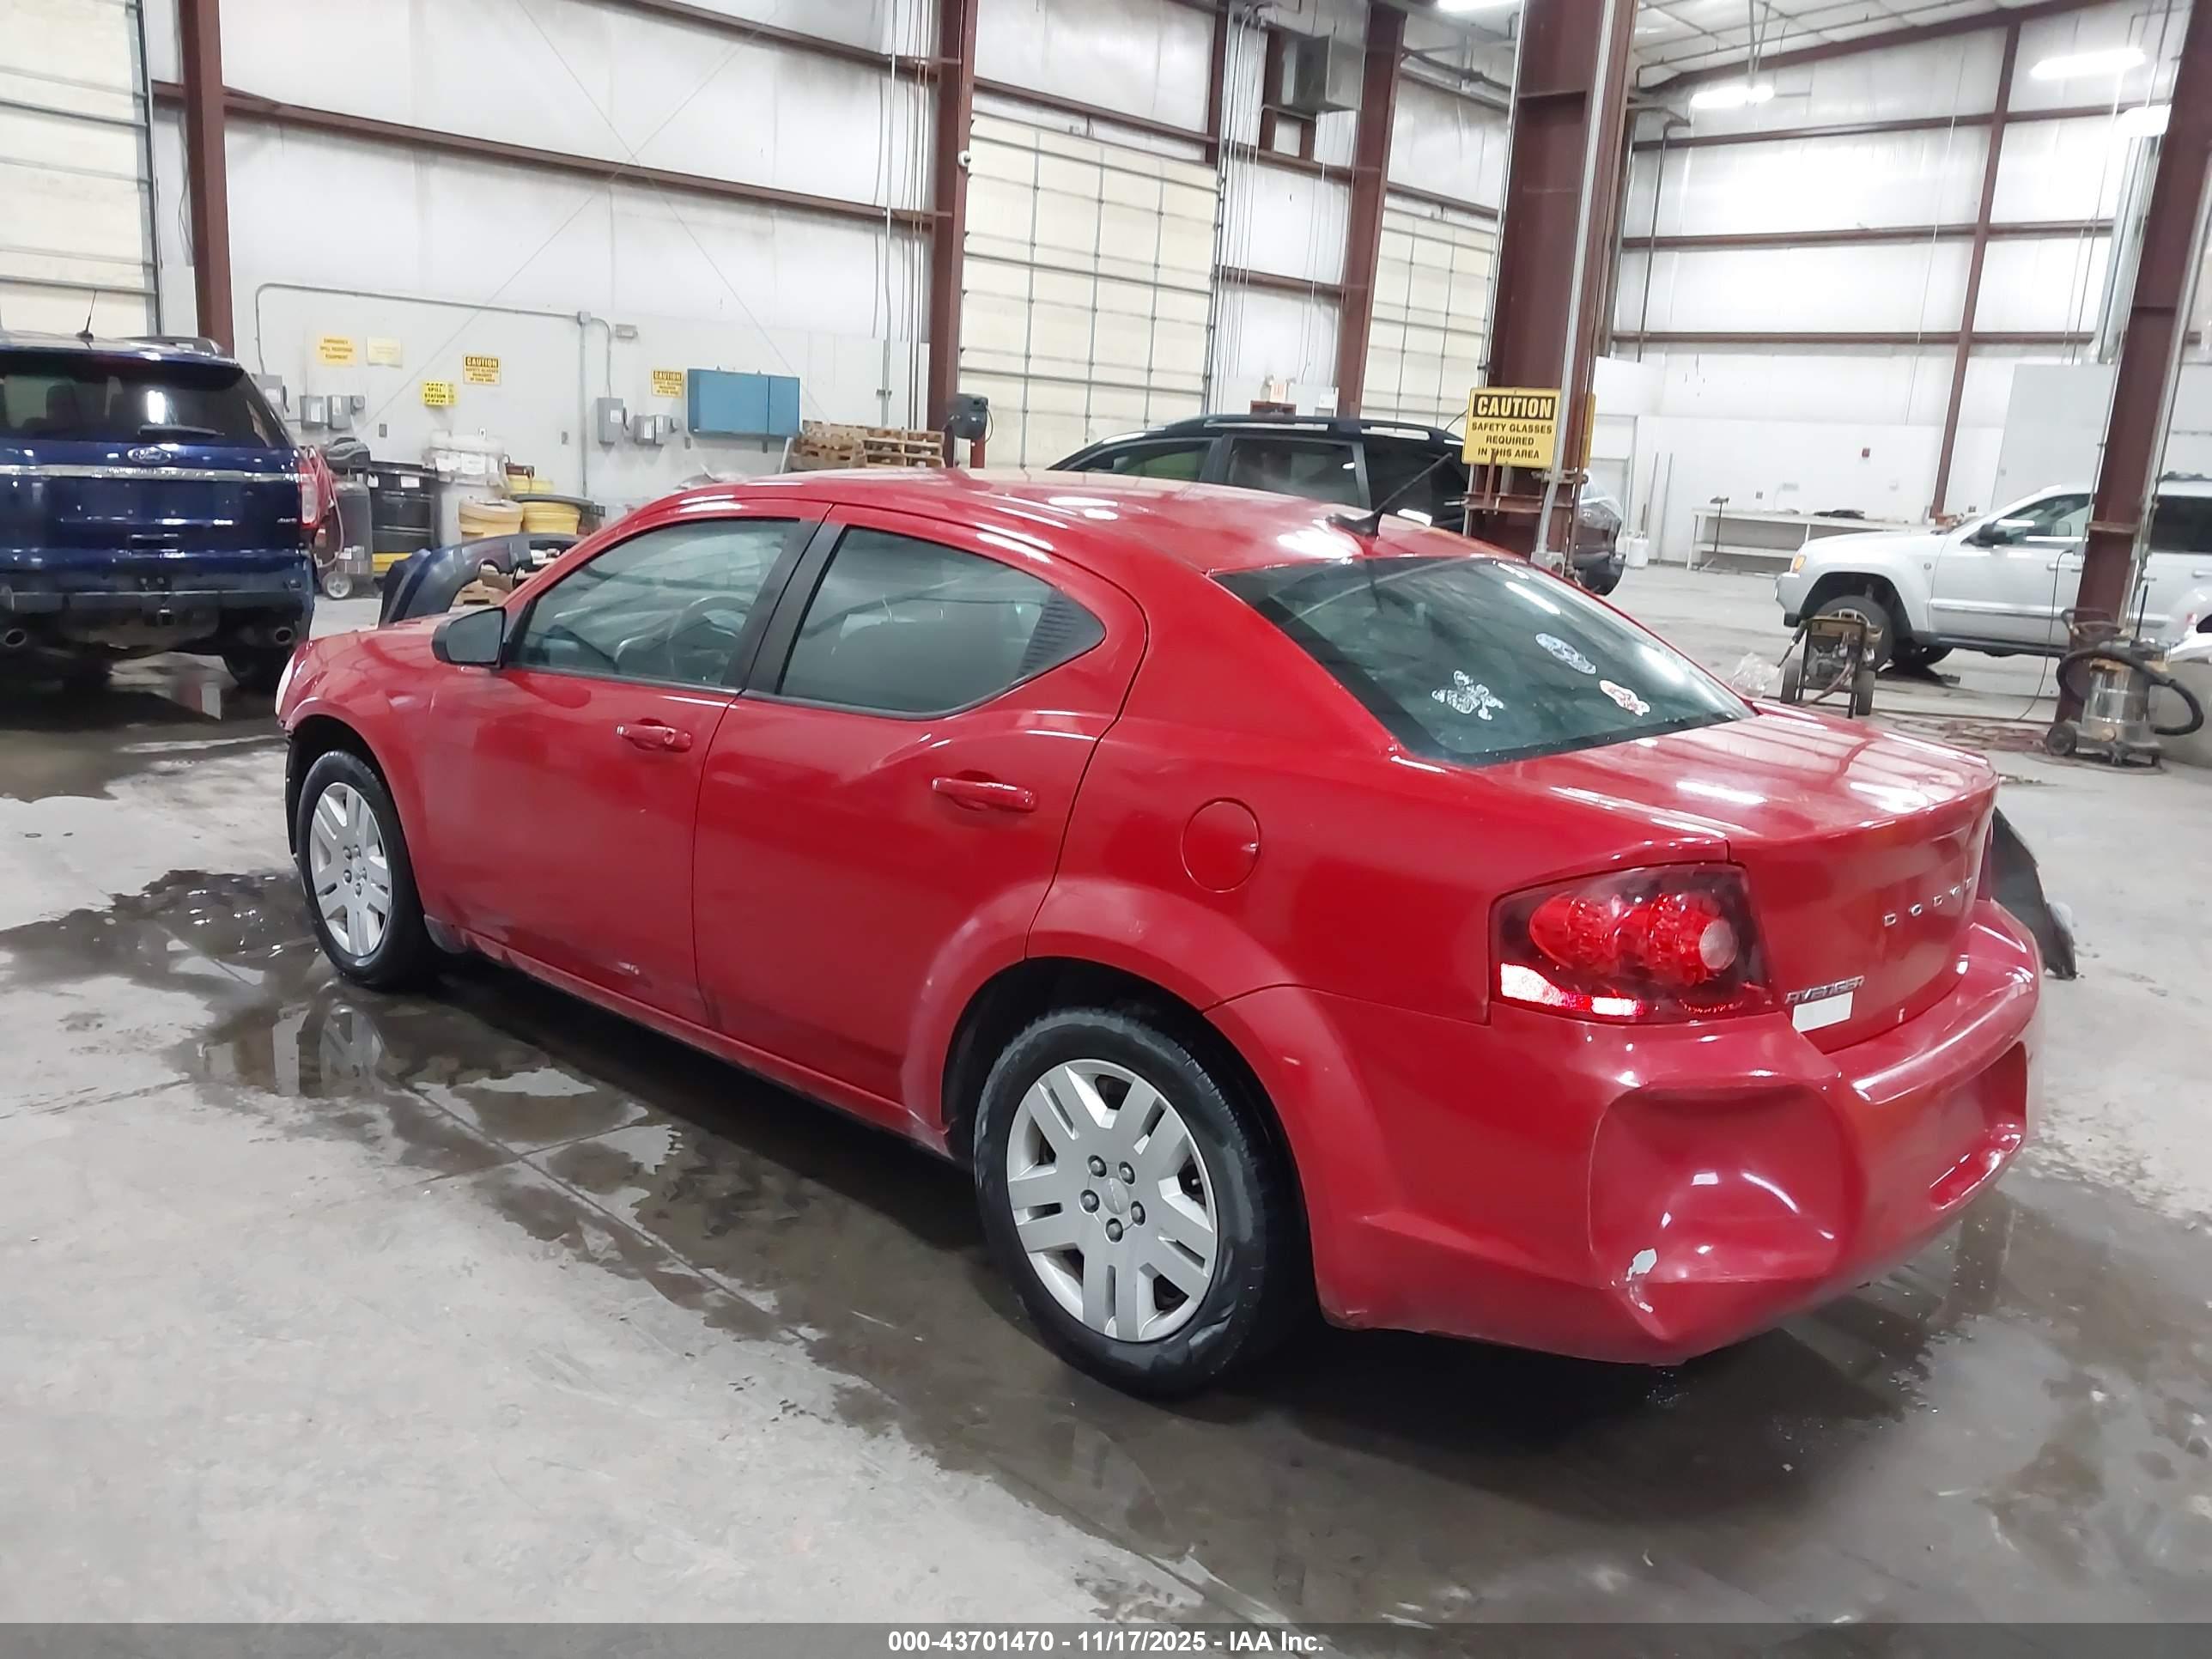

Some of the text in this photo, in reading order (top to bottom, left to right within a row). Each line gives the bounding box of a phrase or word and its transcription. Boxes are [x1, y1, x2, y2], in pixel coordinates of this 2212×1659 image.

[465, 357, 498, 368] CAUTION
[654, 371, 682, 380] CAUTION
[1477, 396, 1553, 419] CAUTION
[1472, 422, 1553, 434] SAFETY GLASSES
[1486, 434, 1534, 446] REQUIRED
[1477, 447, 1487, 457] IN
[1514, 450, 1540, 459] AREA
[1883, 877, 1973, 927] DODGE
[1785, 975, 1865, 1005] AVENGER
